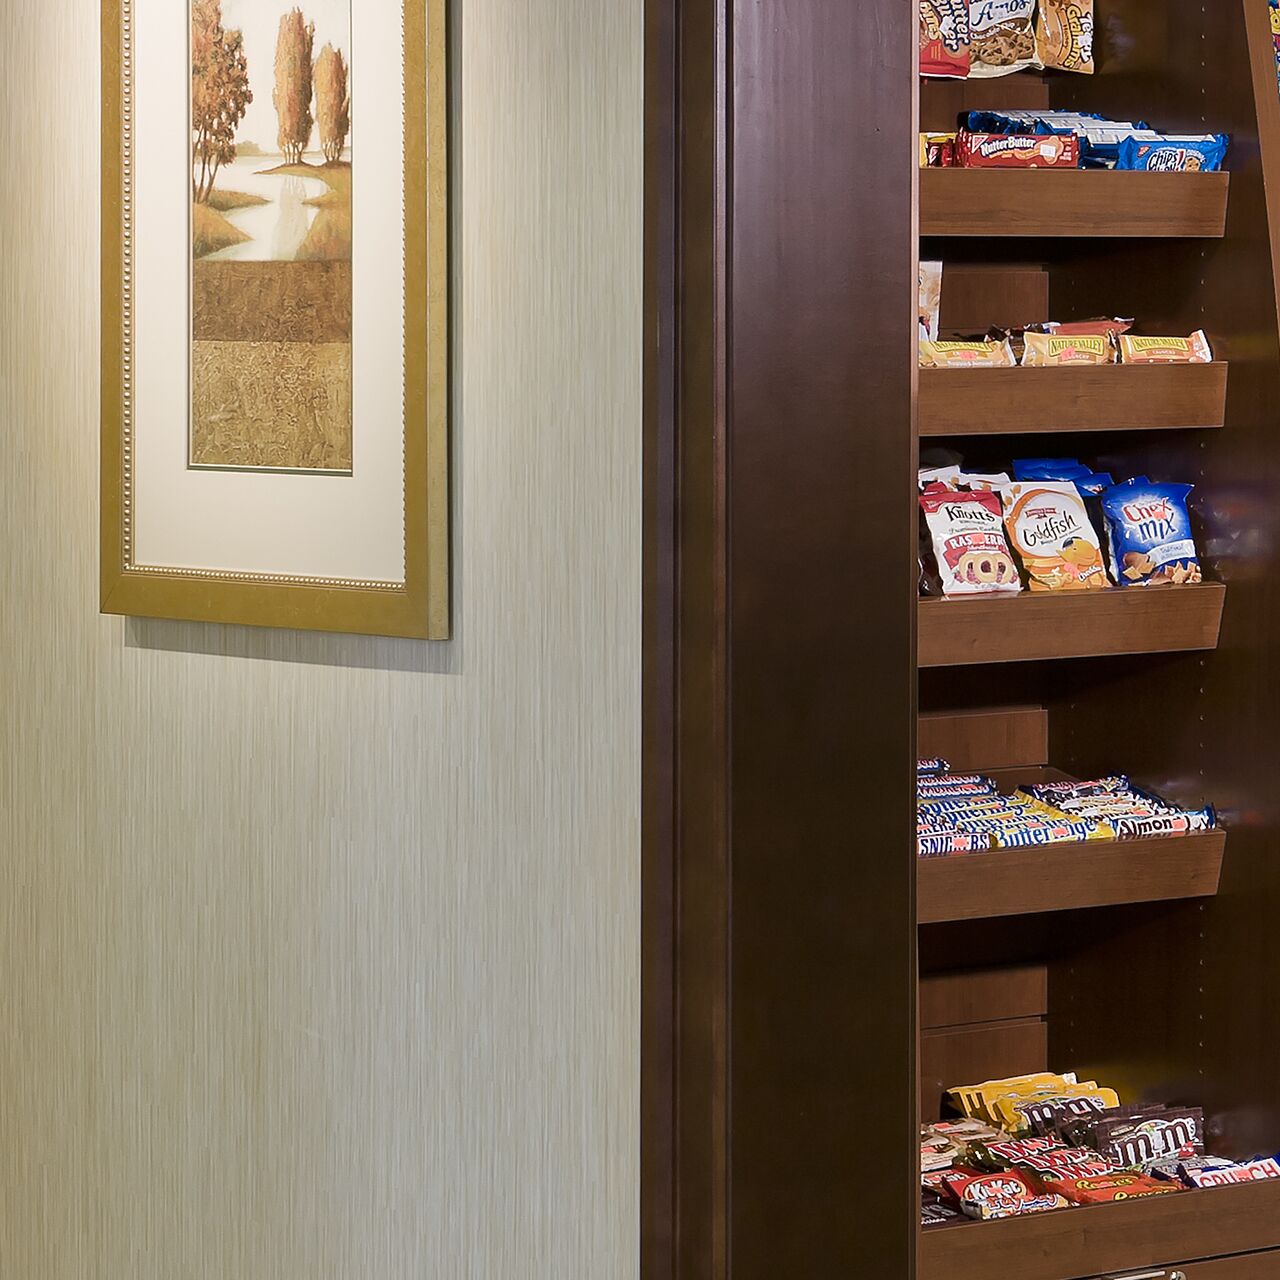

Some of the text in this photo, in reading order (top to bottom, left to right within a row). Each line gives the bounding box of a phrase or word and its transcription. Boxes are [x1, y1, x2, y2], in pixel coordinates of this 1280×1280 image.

[1051, 338, 1103, 353] NATURE VALLEY
[945, 505, 996, 522] Knott's
[1023, 509, 1078, 547] Goldfish
[949, 533, 1006, 550] RASERR
[999, 820, 1098, 849] Butternge
[1118, 816, 1184, 837] Almon
[919, 832, 989, 855] SNICRS
[1116, 1118, 1197, 1166] mm's
[1200, 1161, 1279, 1188] CRUCH
